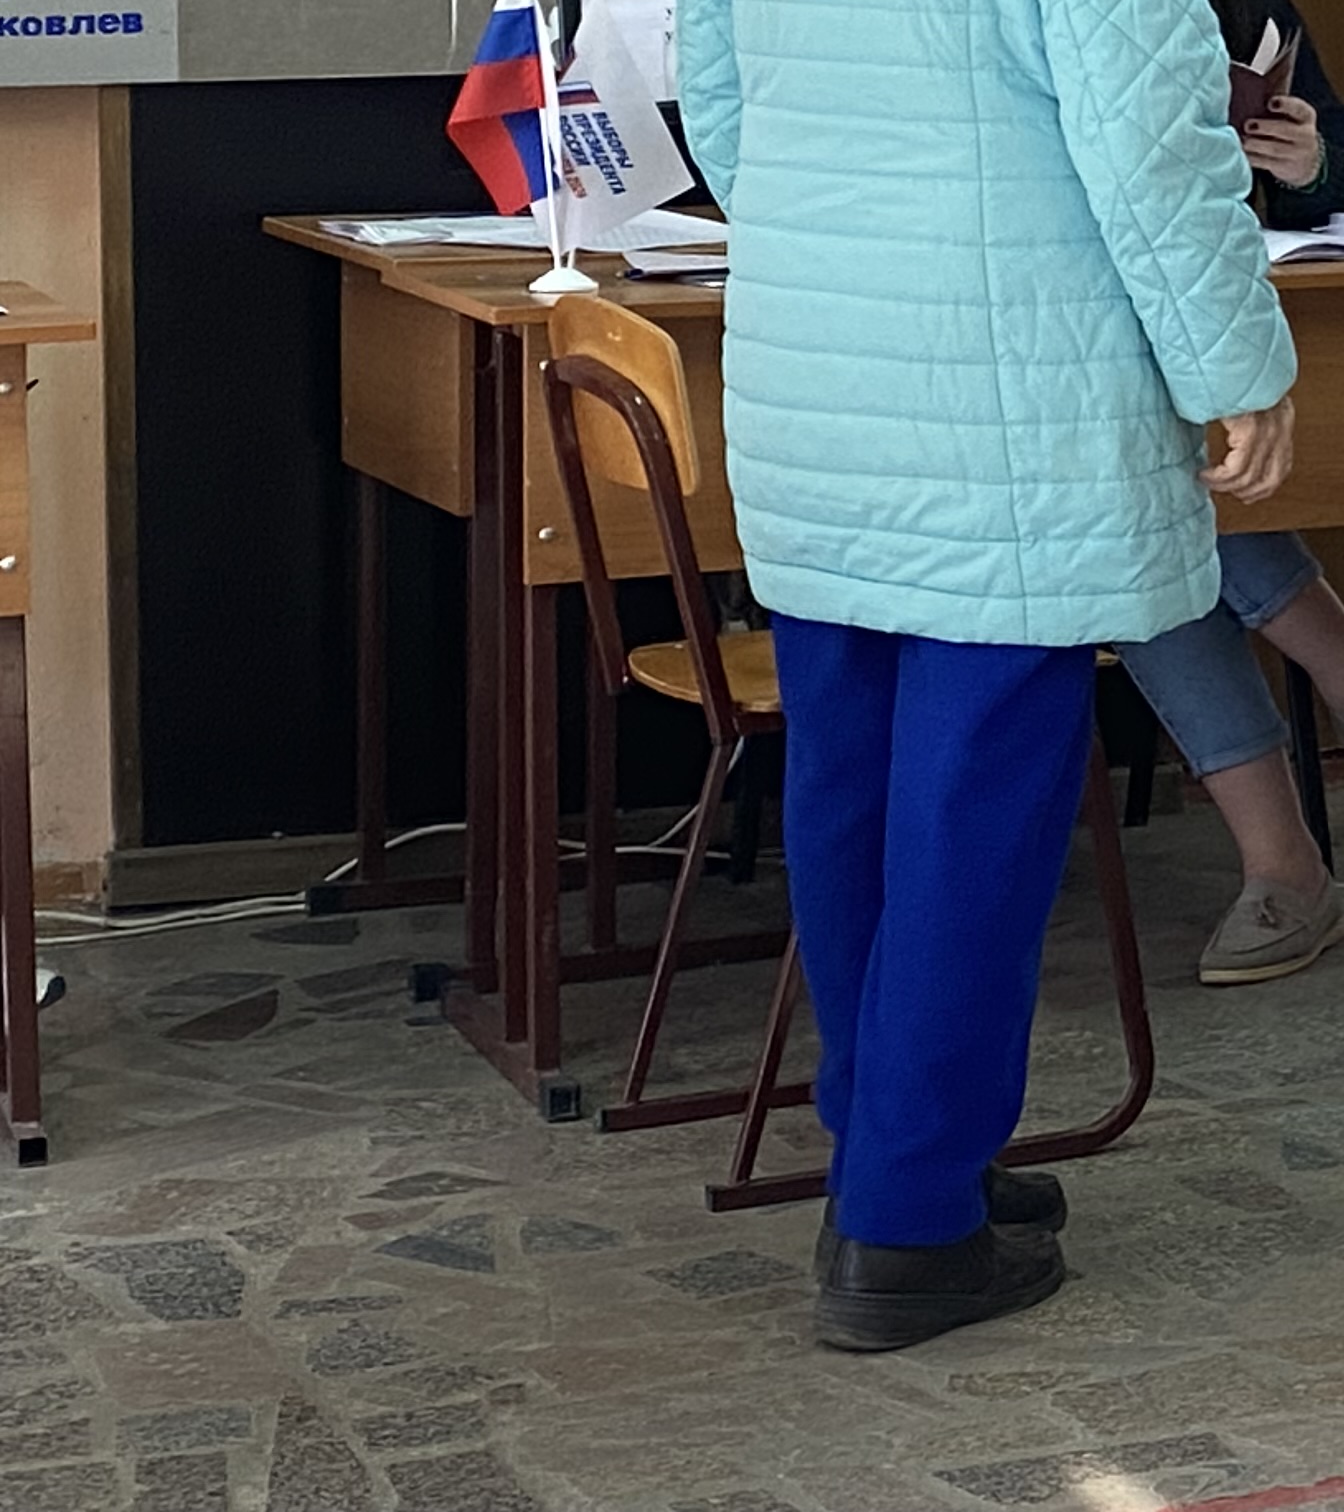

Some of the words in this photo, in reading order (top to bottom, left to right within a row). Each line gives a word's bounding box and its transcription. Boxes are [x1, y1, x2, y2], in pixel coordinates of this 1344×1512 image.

[0, 13, 143, 36] ковлев
[571, 112, 627, 195] ПРЕЗИДЕНТА
[592, 111, 634, 169] ВЫБОРЫ
